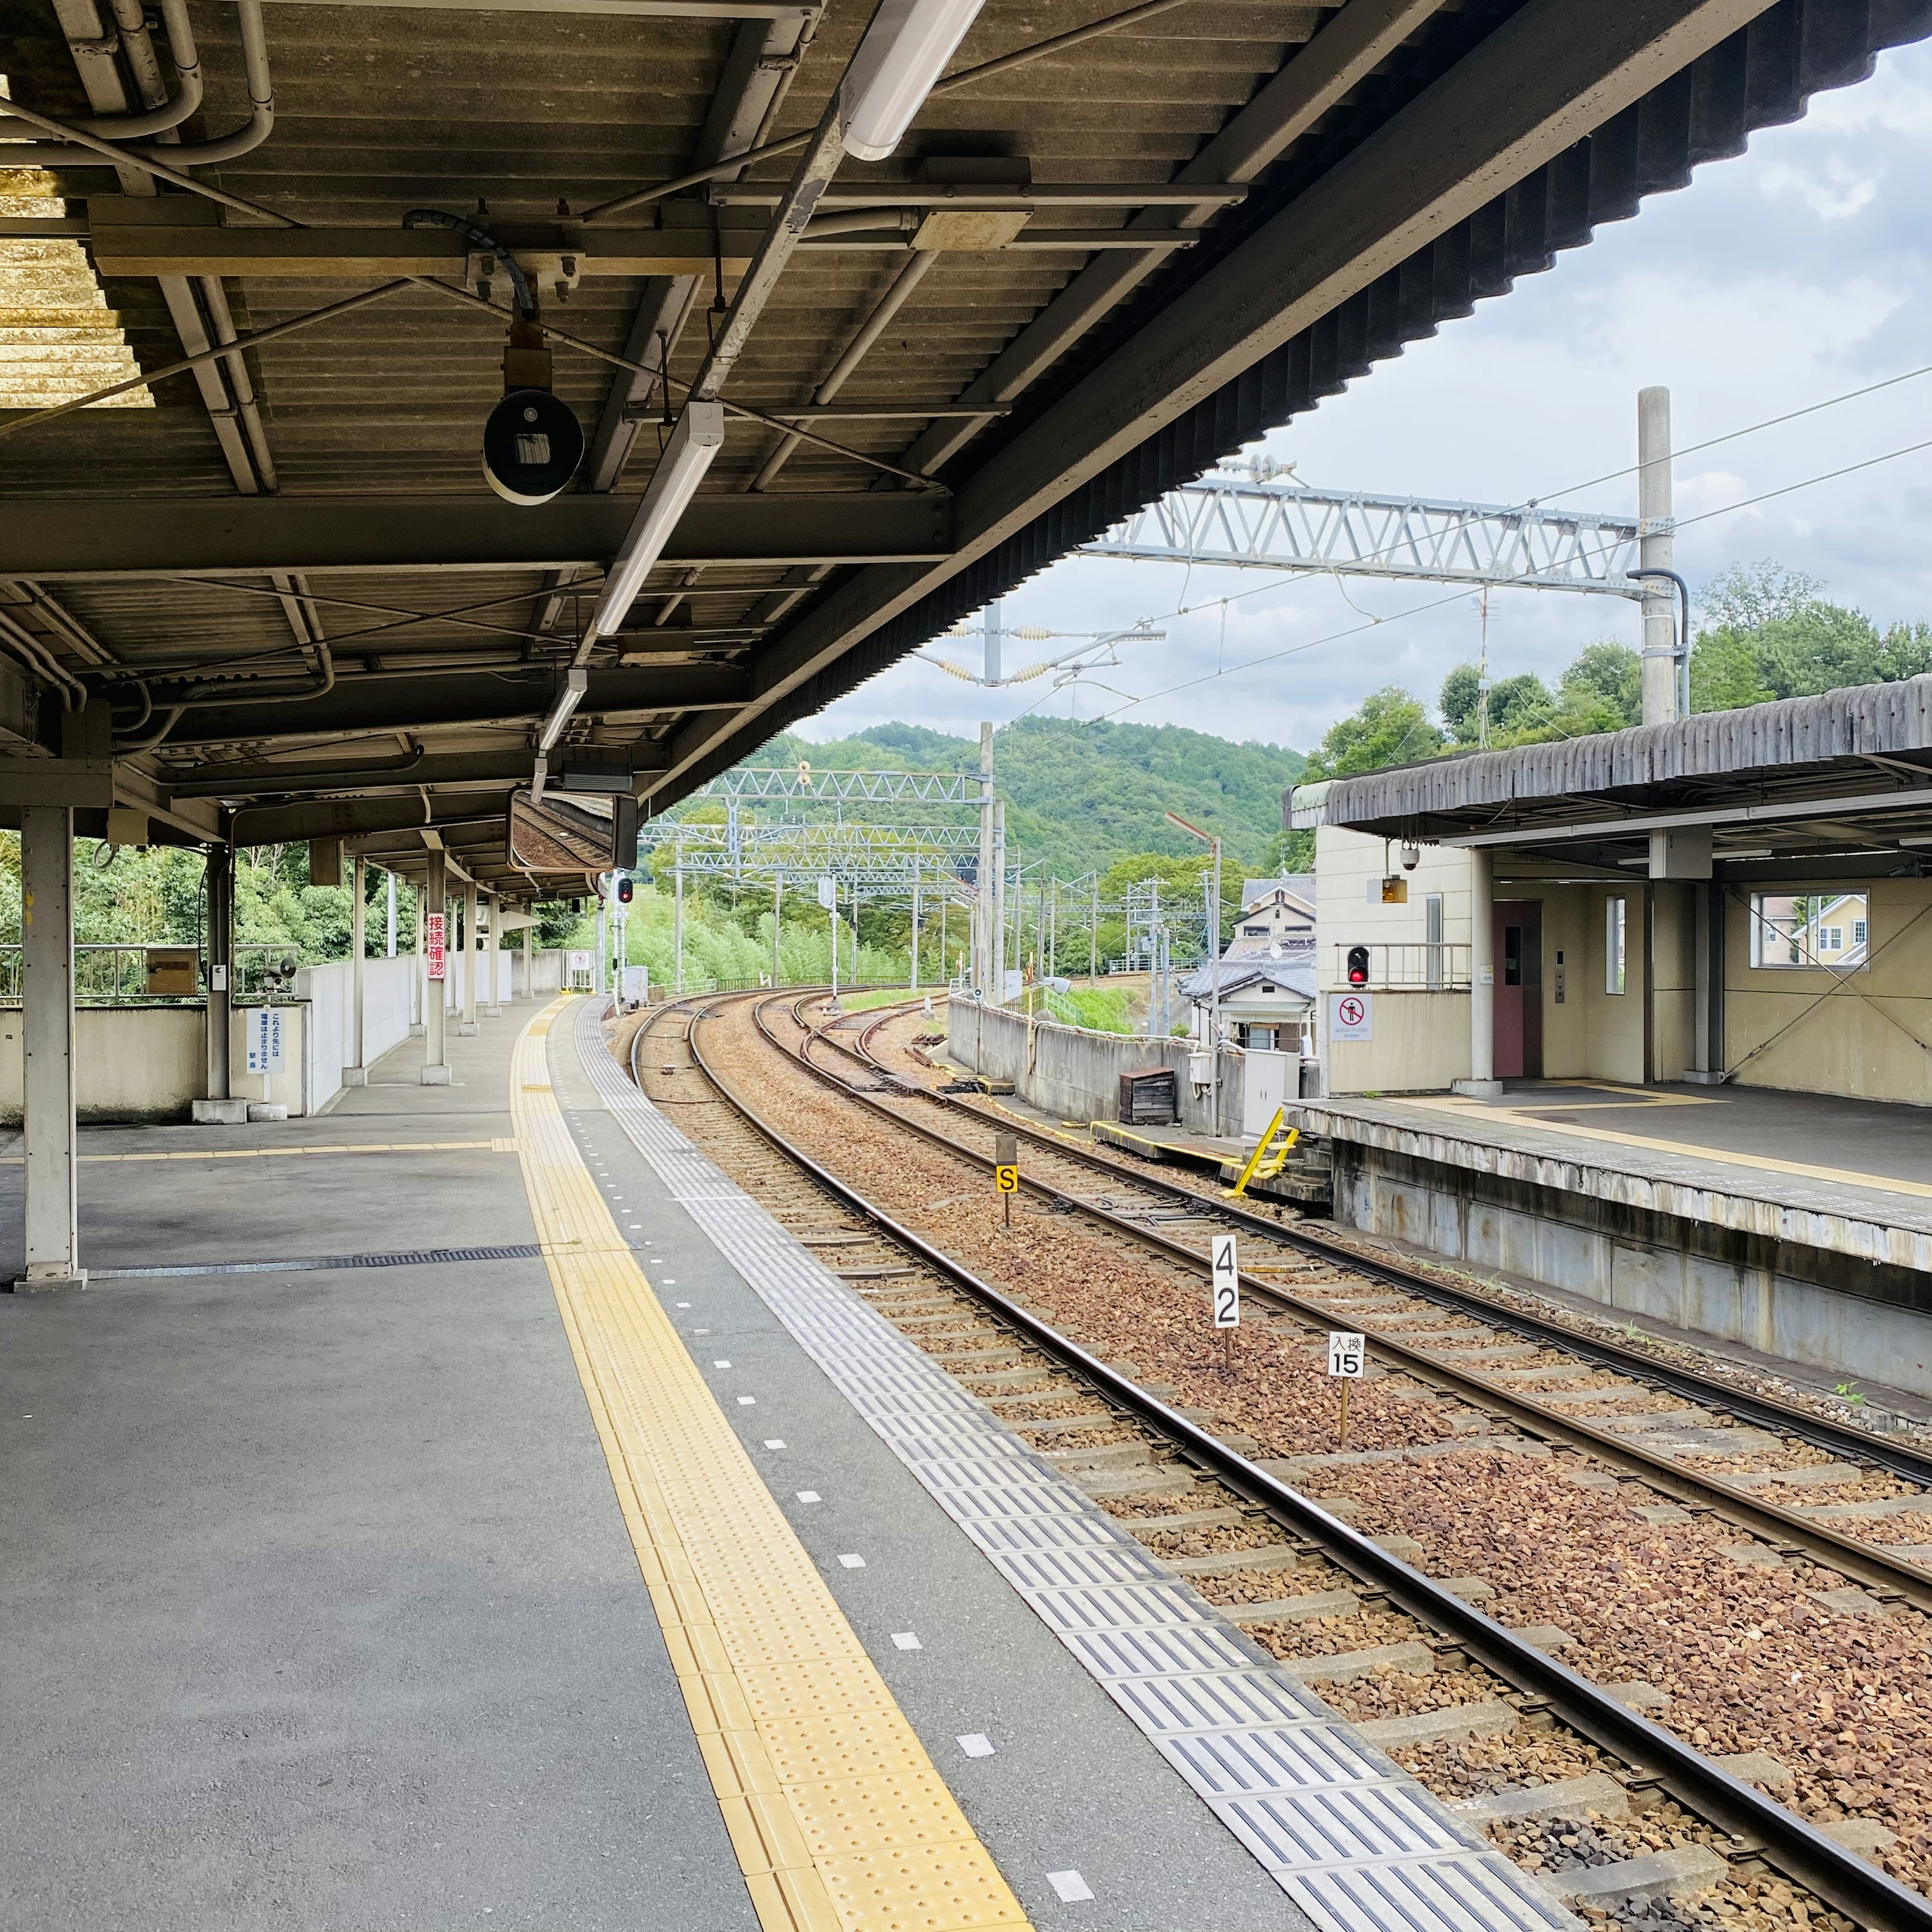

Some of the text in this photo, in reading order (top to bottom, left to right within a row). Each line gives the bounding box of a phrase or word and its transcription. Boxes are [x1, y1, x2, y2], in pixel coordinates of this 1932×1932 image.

[429, 916, 443, 976] 接続確認
[260, 1013, 268, 1069] 電車は止まりません
[1000, 1168, 1014, 1190] S
[1216, 1241, 1234, 1276] 4
[1218, 1286, 1237, 1323] 2
[1332, 1336, 1362, 1352] 入換
[1333, 1353, 1359, 1374] 15
